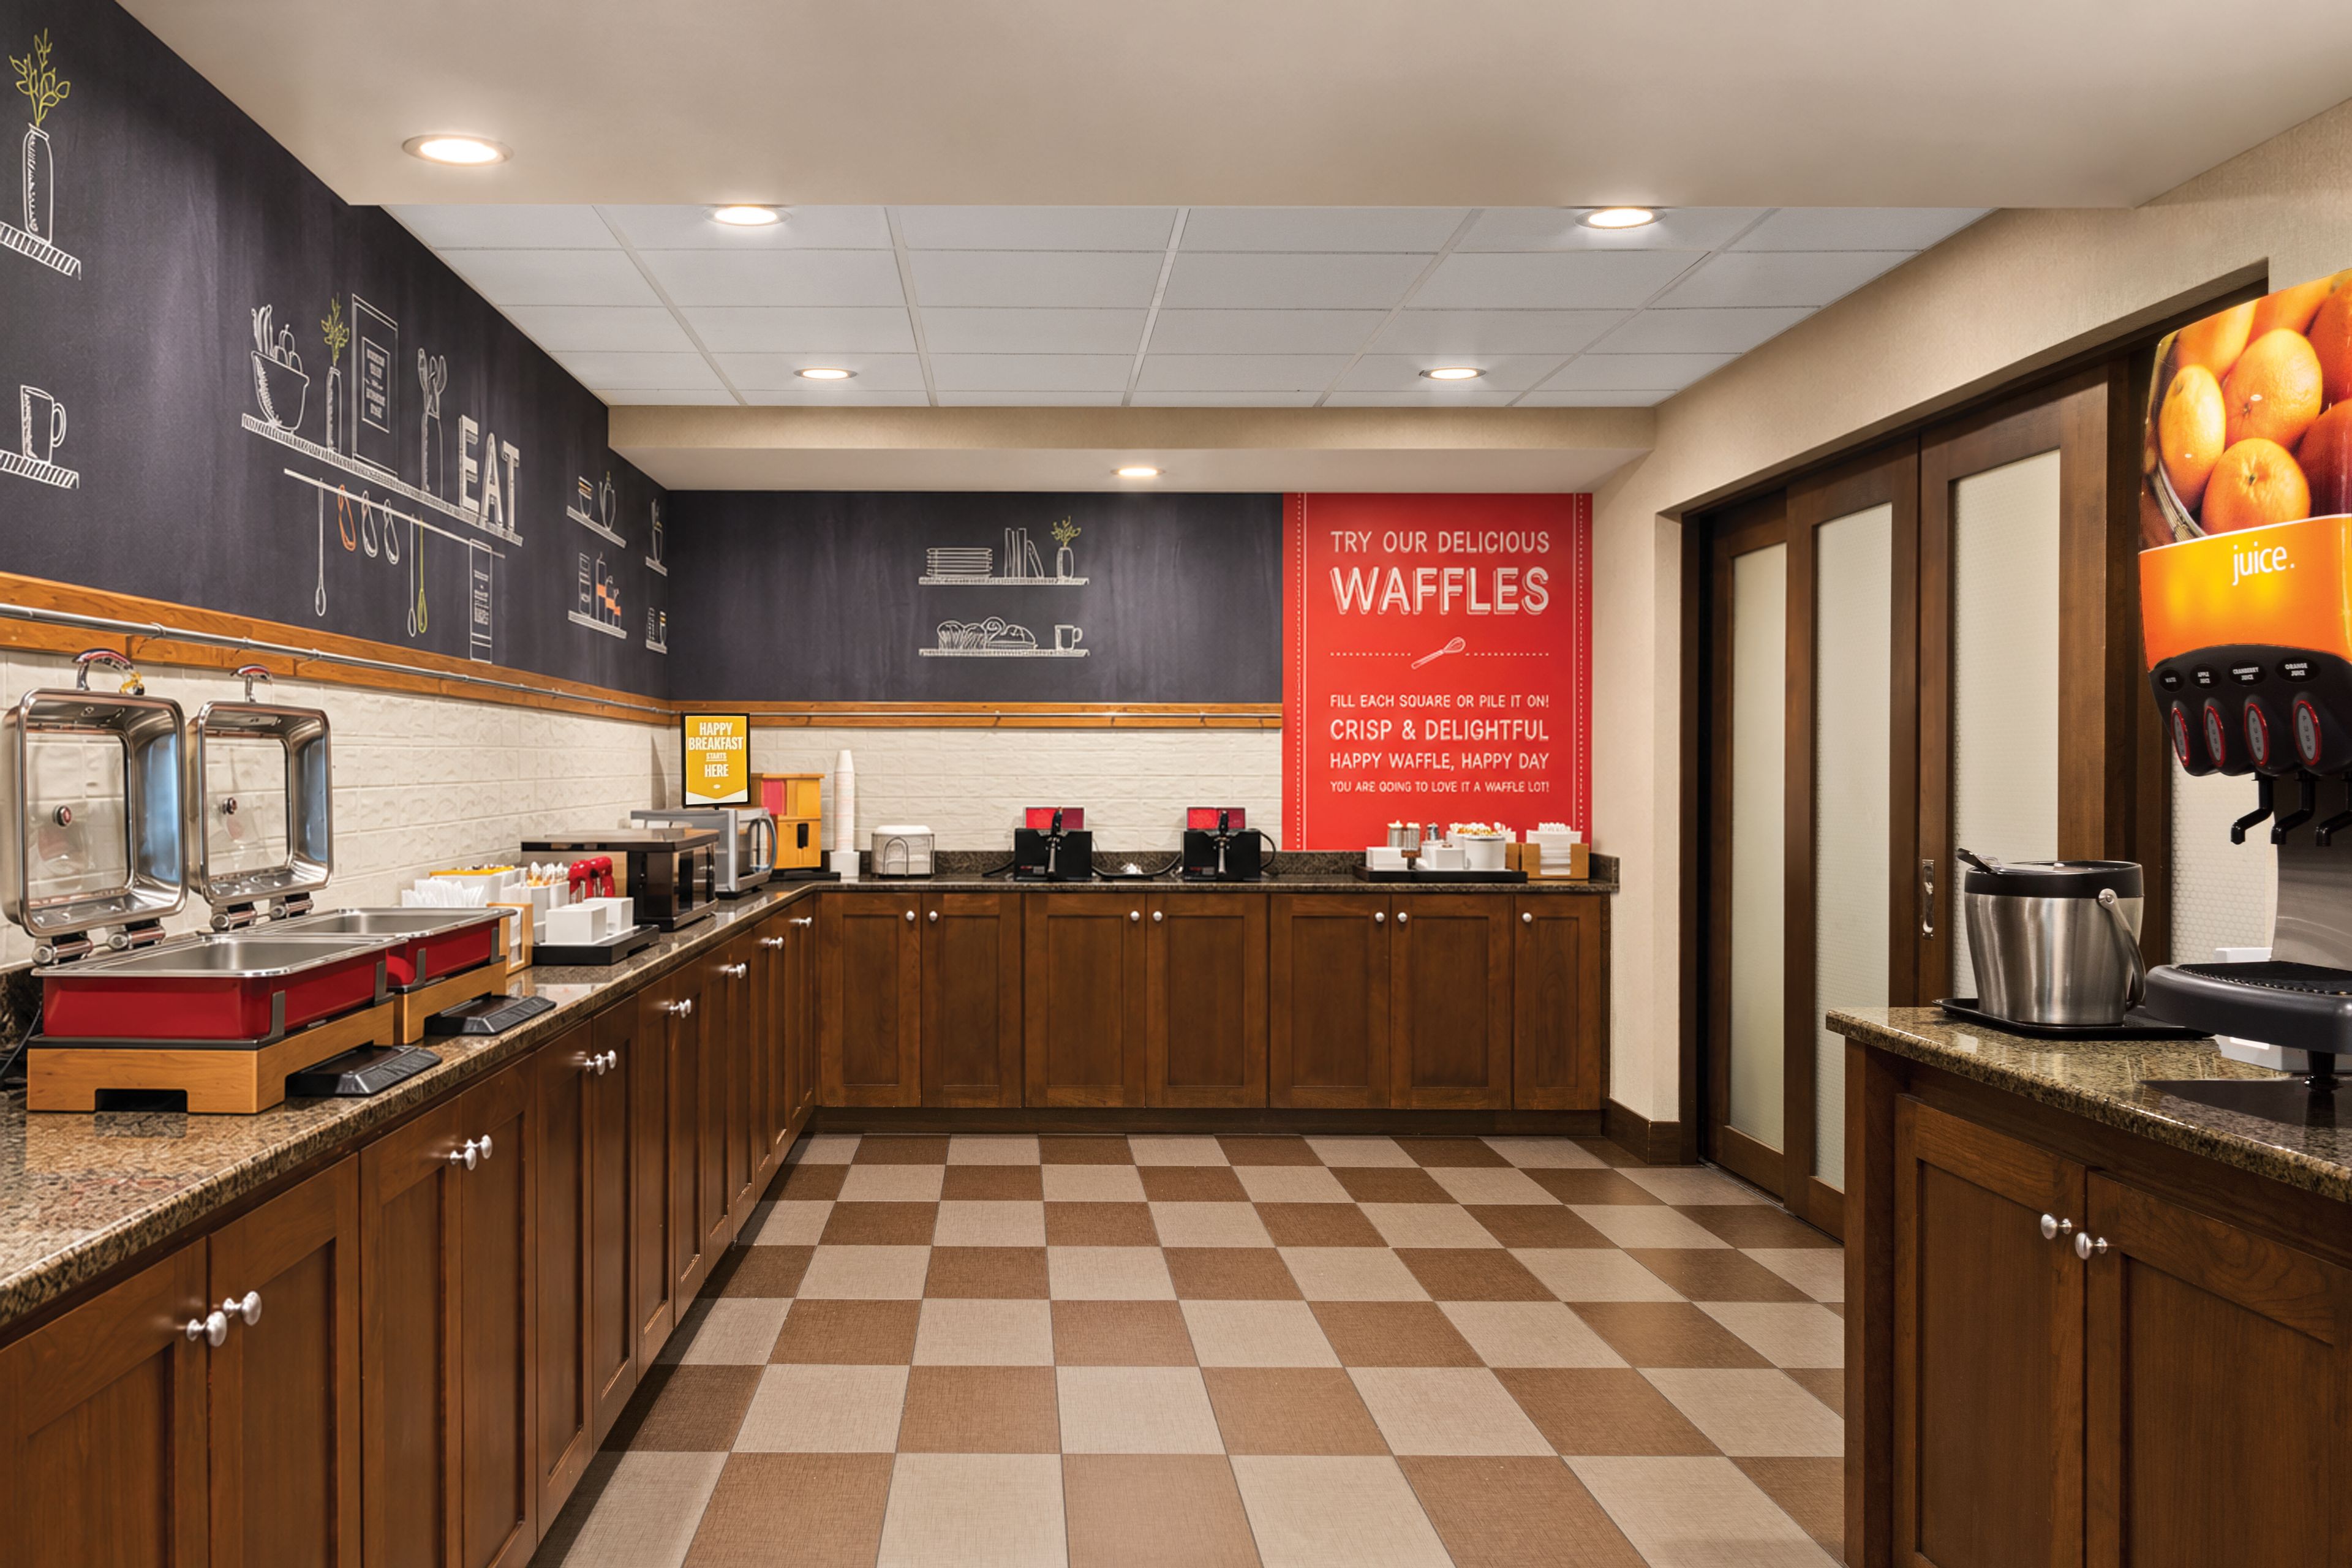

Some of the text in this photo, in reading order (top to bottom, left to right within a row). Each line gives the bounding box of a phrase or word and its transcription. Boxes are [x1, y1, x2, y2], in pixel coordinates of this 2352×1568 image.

[459, 415, 519, 532] EAT
[1330, 530, 1550, 553] TRY OUR DELICIOUS
[1330, 566, 1550, 615] WAFFLES
[1330, 694, 1549, 708] FILL EACH SQUARE OR PILE IT ON!
[699, 722, 733, 736] HAPPY
[1330, 718, 1549, 741] CRISP & DELIGHTFUL
[688, 736, 744, 750] BREAKFAST
[1330, 752, 1550, 771] HAPPY WAFFLE, HAPPY DAY
[704, 764, 729, 777] HERE
[1330, 781, 1550, 793] YOU ARE GOING TO LOVE IT A WAFFLE LOT!
